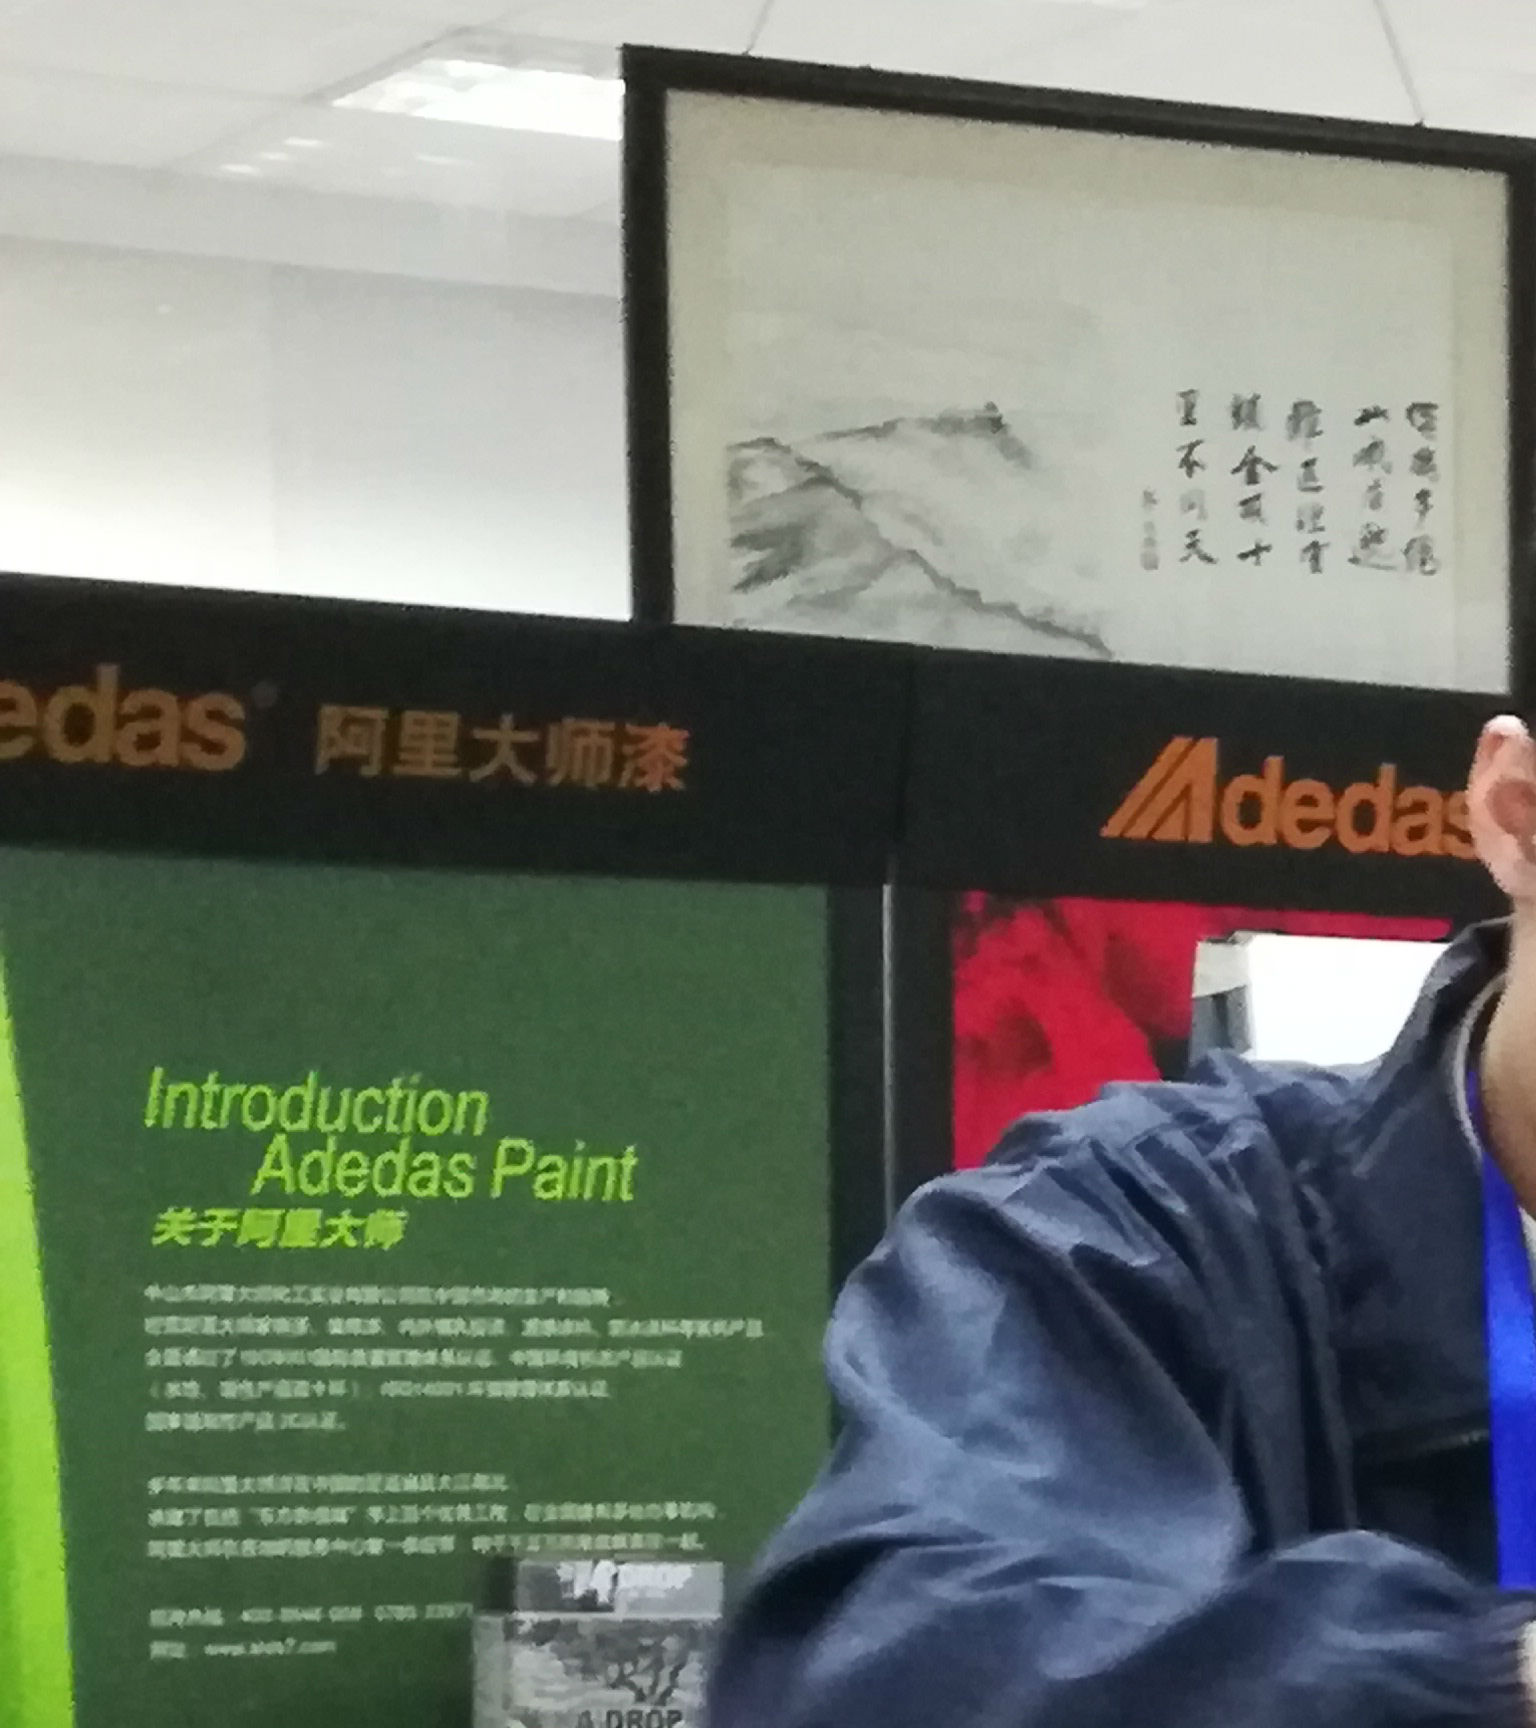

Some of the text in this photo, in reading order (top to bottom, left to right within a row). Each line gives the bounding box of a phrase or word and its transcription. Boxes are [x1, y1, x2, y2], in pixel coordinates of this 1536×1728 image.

[314, 704, 690, 793] 阿里大师漆
[144, 1066, 489, 1136] Introduction
[250, 1132, 638, 1202] Adedas Paint
